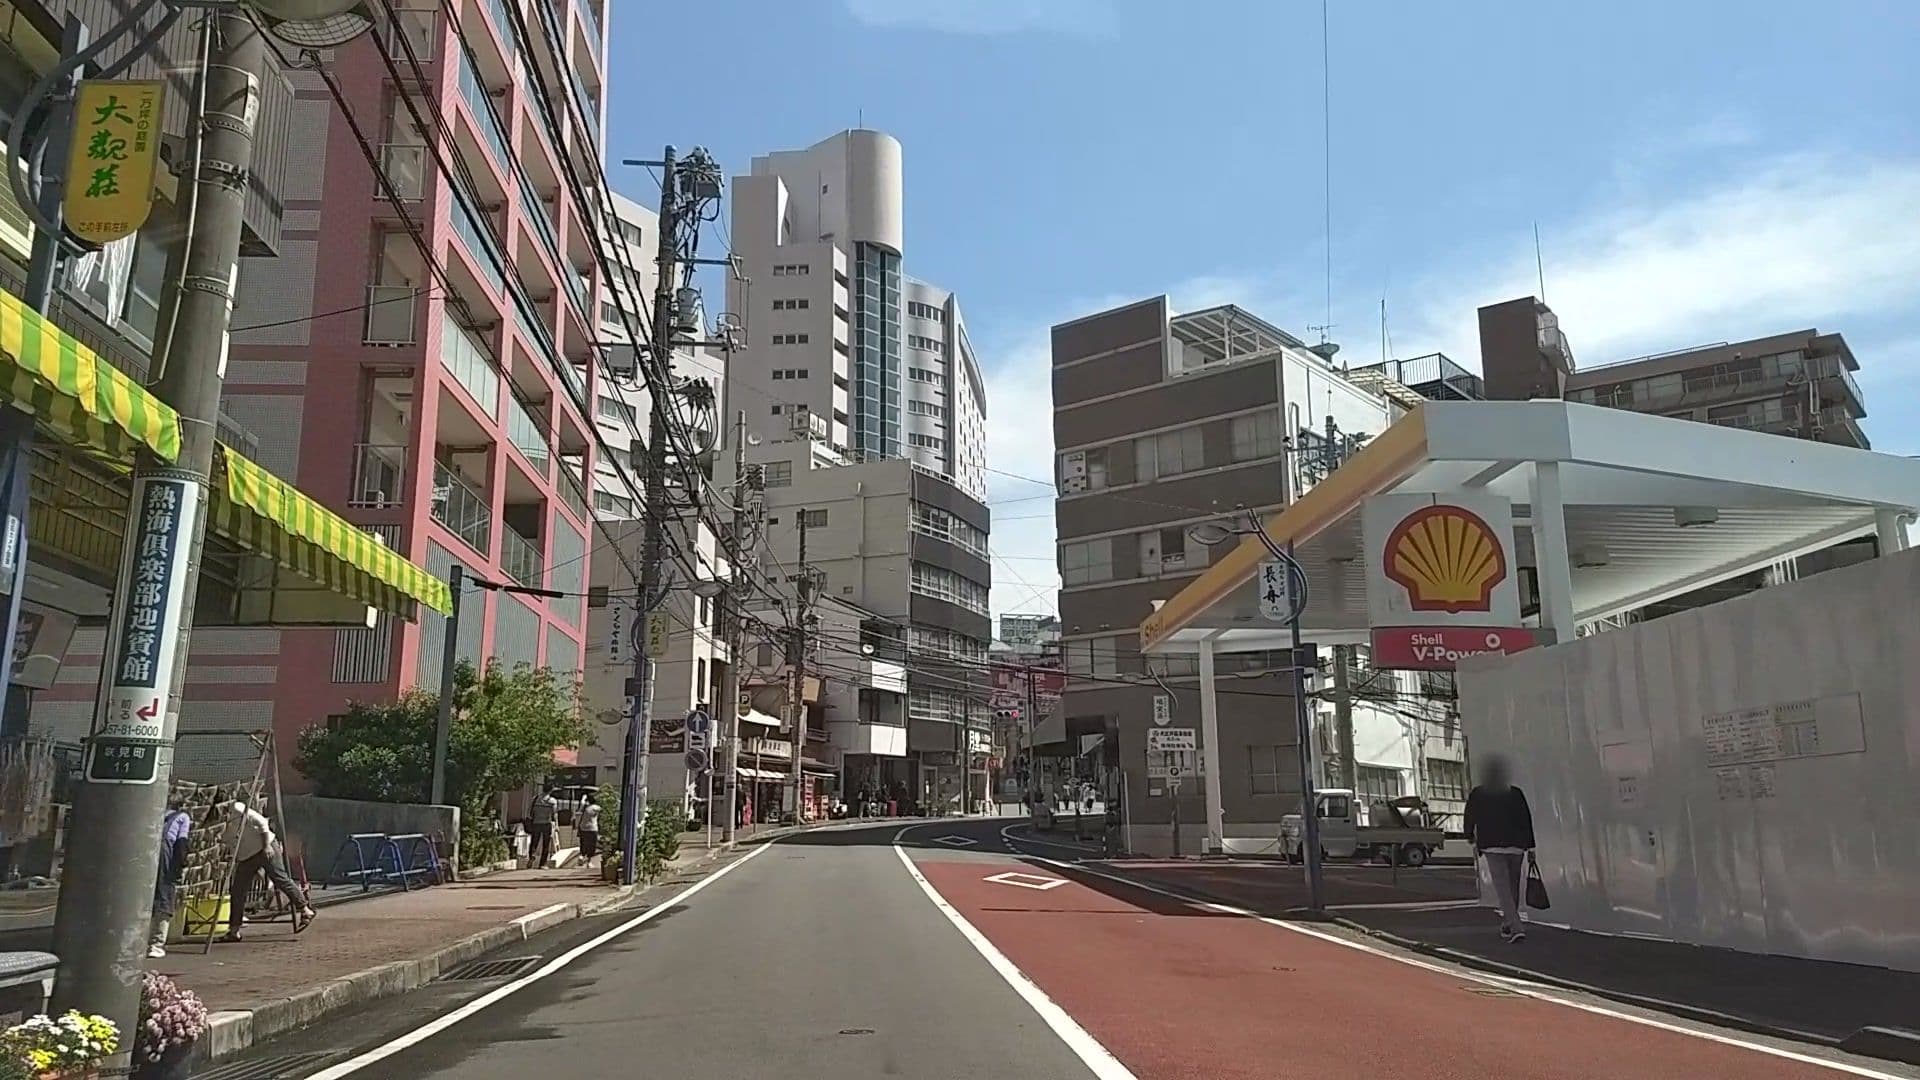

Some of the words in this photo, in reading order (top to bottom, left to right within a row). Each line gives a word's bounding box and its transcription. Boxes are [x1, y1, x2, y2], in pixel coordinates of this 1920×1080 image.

[122, 484, 176, 682] 熱海倶楽部迎賓館
[1411, 633, 1443, 646] Shell
